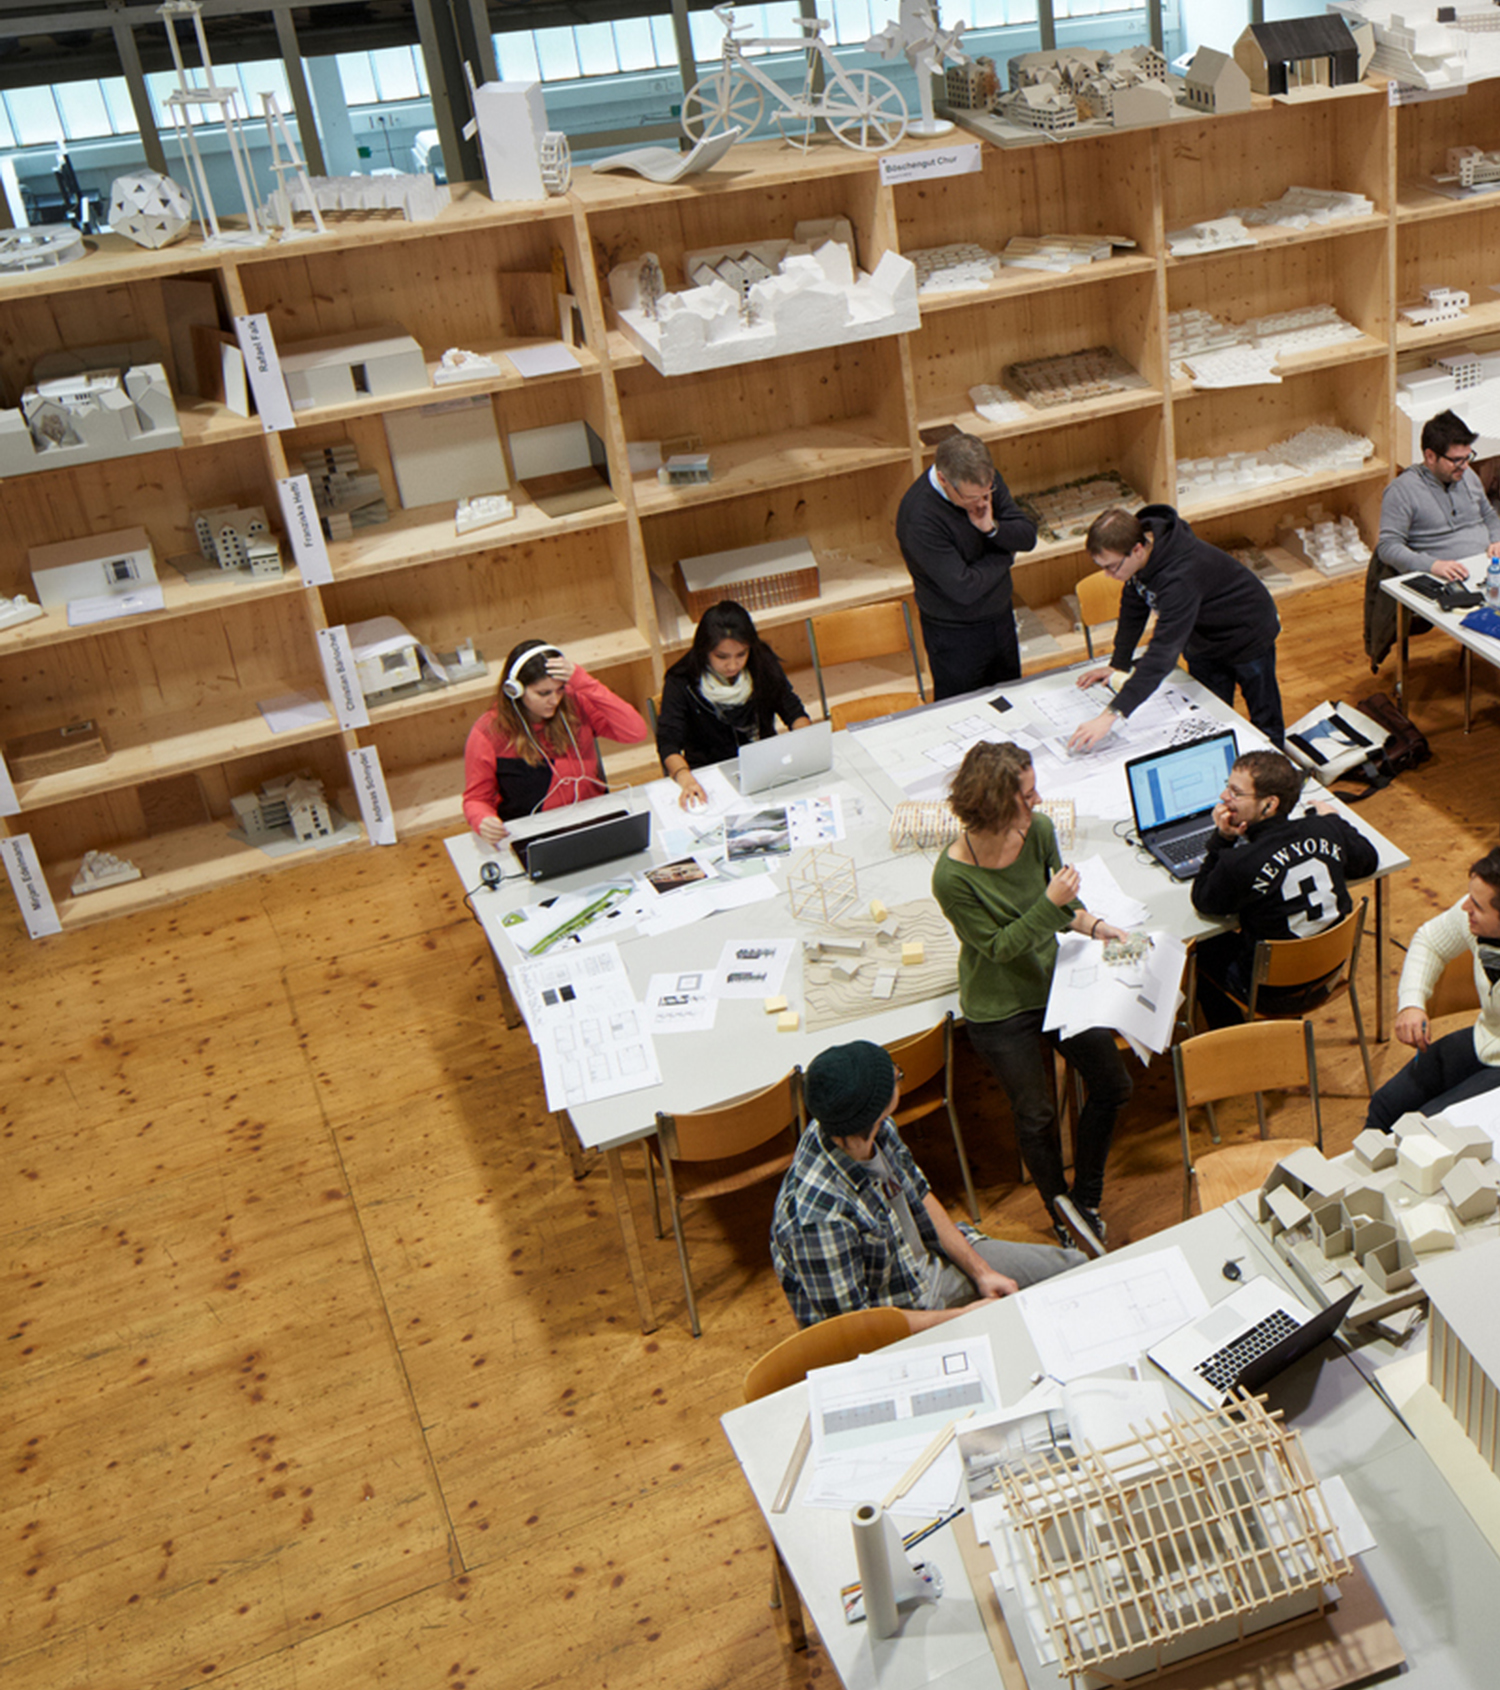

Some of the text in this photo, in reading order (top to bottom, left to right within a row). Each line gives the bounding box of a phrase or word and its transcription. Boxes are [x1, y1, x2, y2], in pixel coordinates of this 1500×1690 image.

[247, 320, 269, 373] Rafael Falk
[297, 504, 313, 548] Franziska
[340, 674, 355, 711] Christian
[370, 790, 384, 823] Andreas
[1281, 857, 1340, 939] 3
